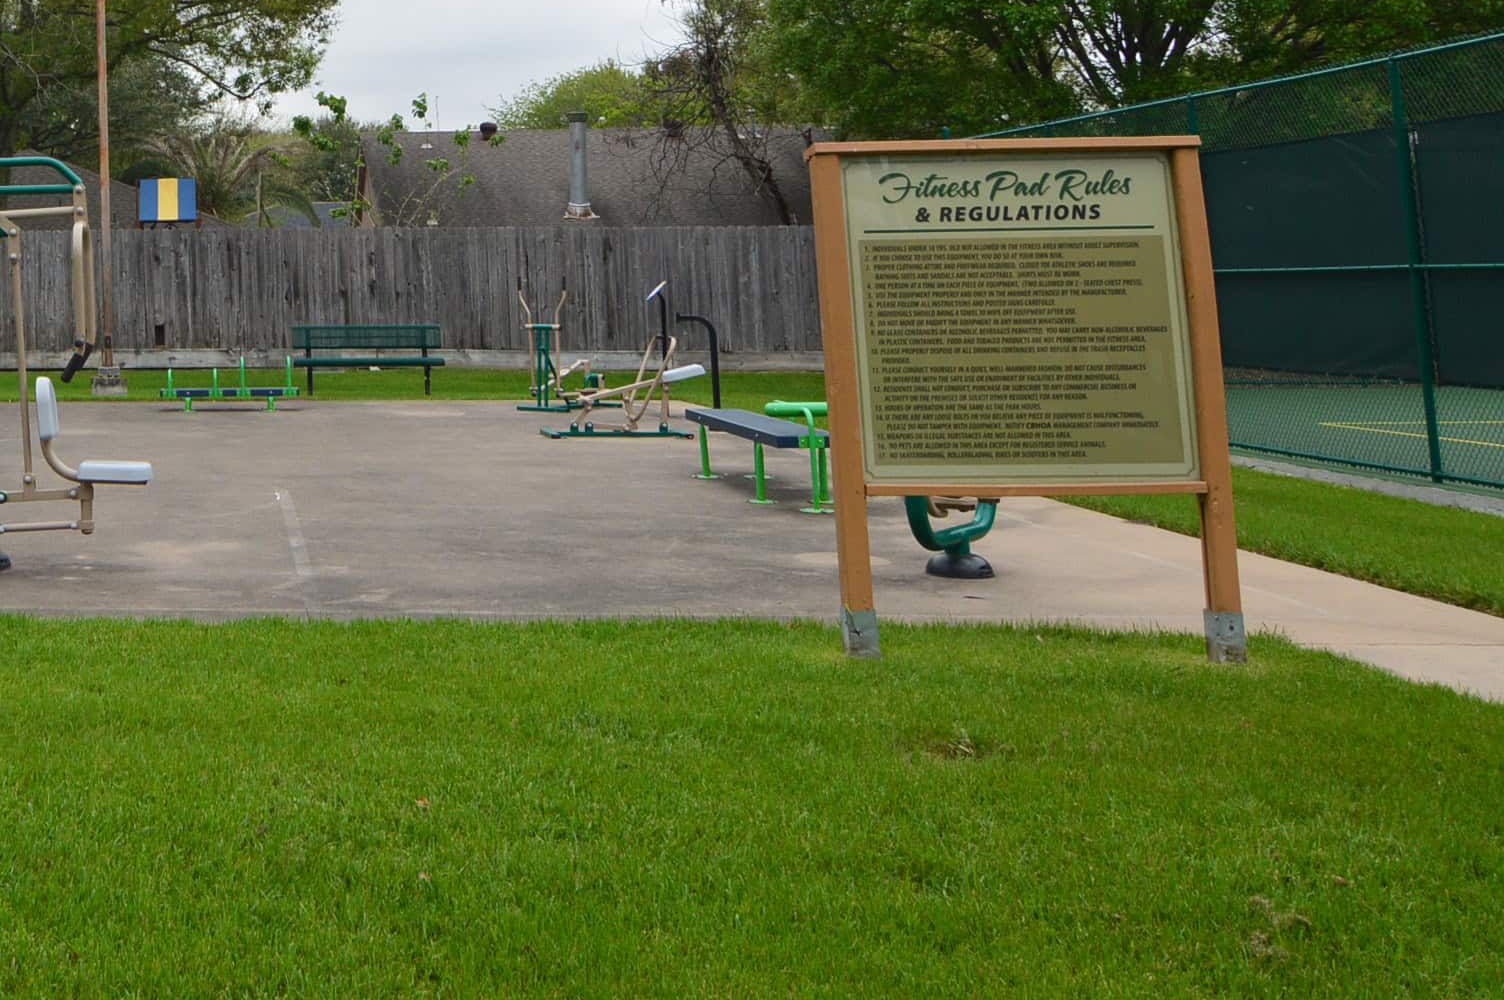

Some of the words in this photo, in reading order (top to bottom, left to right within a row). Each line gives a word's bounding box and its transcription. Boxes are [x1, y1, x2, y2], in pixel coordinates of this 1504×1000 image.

[878, 169, 981, 204] Fitness
[986, 171, 1050, 201] Pad
[1054, 169, 1132, 201] Rules
[915, 206, 930, 223] &
[939, 204, 1102, 223] REGULATIONS
